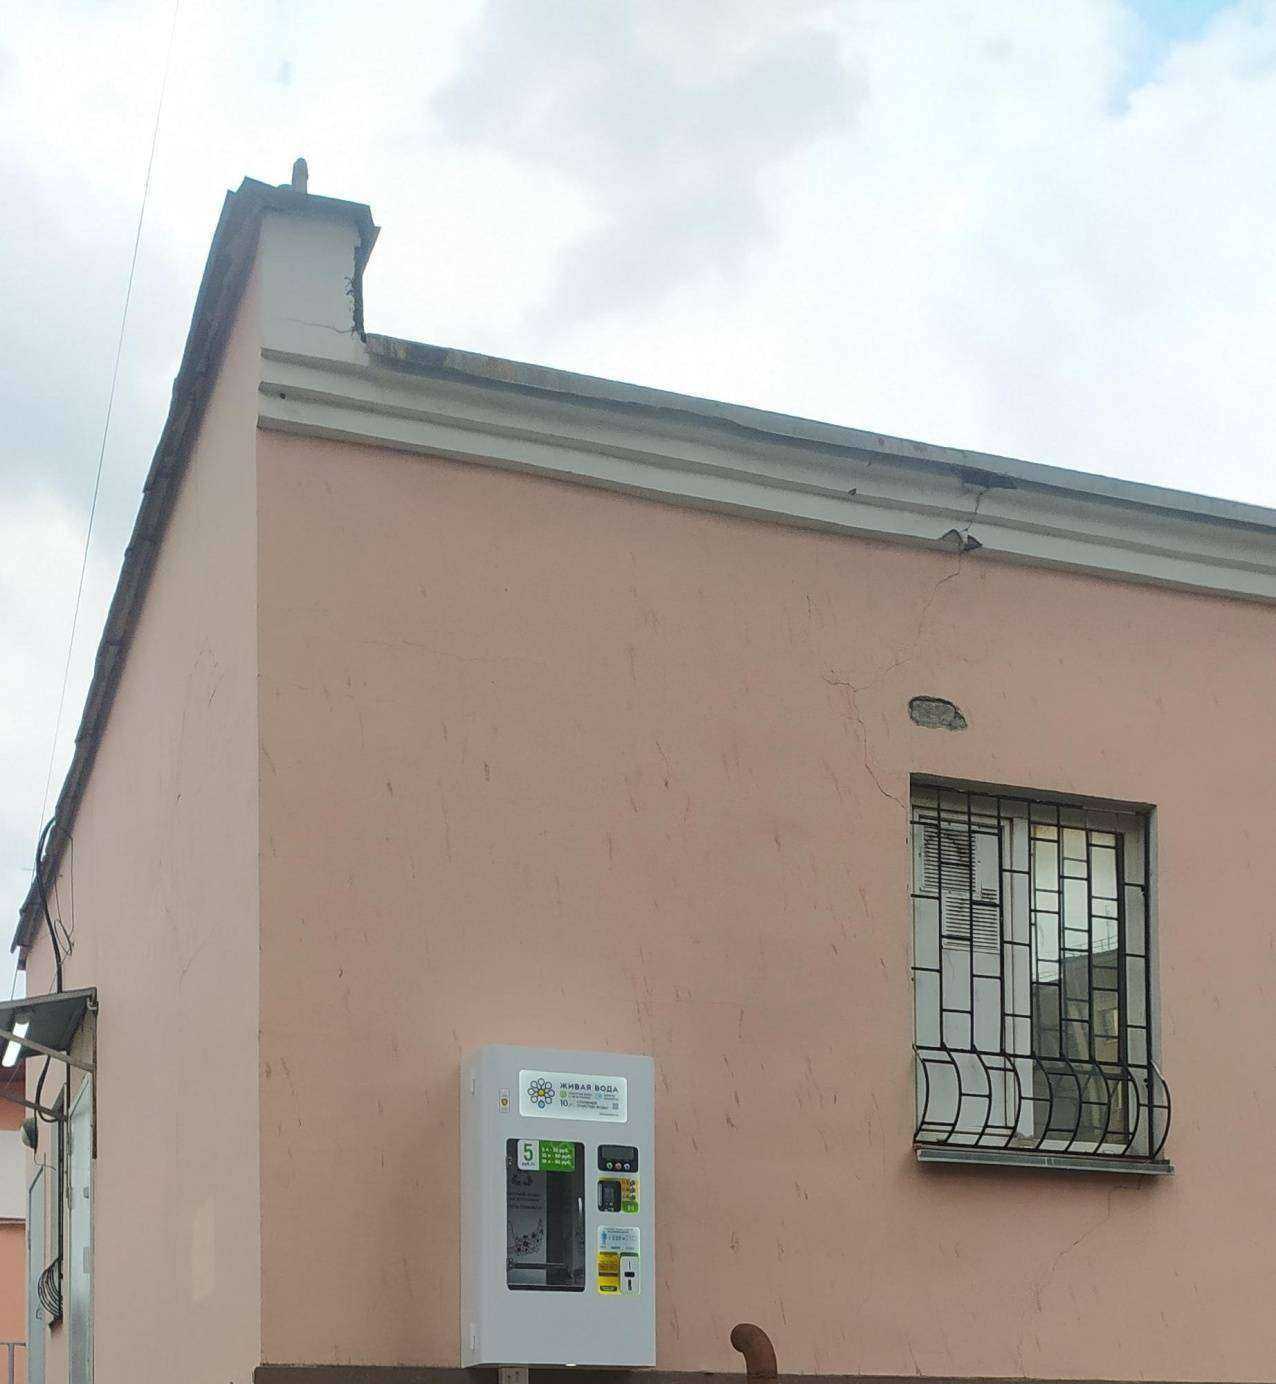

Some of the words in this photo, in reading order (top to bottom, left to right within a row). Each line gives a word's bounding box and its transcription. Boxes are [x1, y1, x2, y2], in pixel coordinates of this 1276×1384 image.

[560, 1082, 592, 1091] ЖИВАЯ
[594, 1084, 619, 1093] ВОДА
[560, 1099, 569, 1107] 10
[523, 1143, 533, 1161] 5
